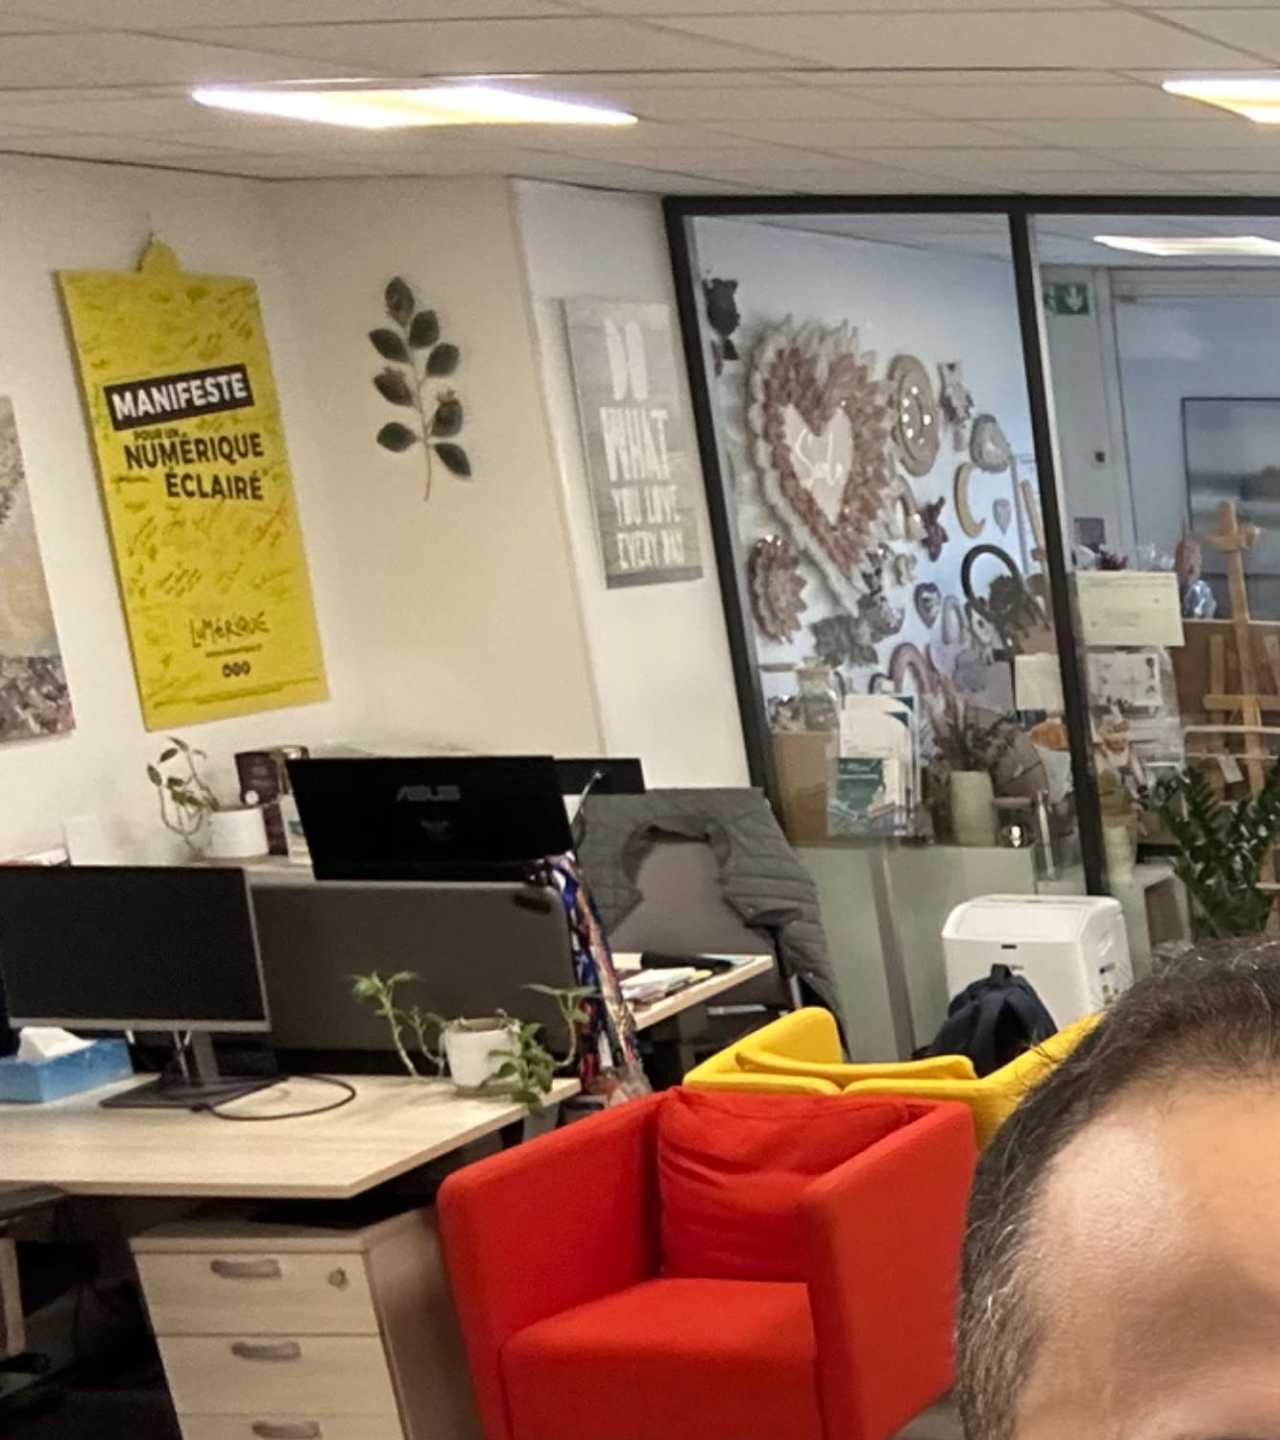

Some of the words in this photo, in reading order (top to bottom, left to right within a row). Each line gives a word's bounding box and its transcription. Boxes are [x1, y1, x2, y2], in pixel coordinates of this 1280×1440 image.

[111, 372, 249, 421] MANIFESTE
[123, 430, 265, 471] NUMÉRIQUE
[599, 406, 671, 482] WHAT
[164, 466, 265, 501] ÉCLAIRÉ
[396, 784, 461, 801] ASUS
